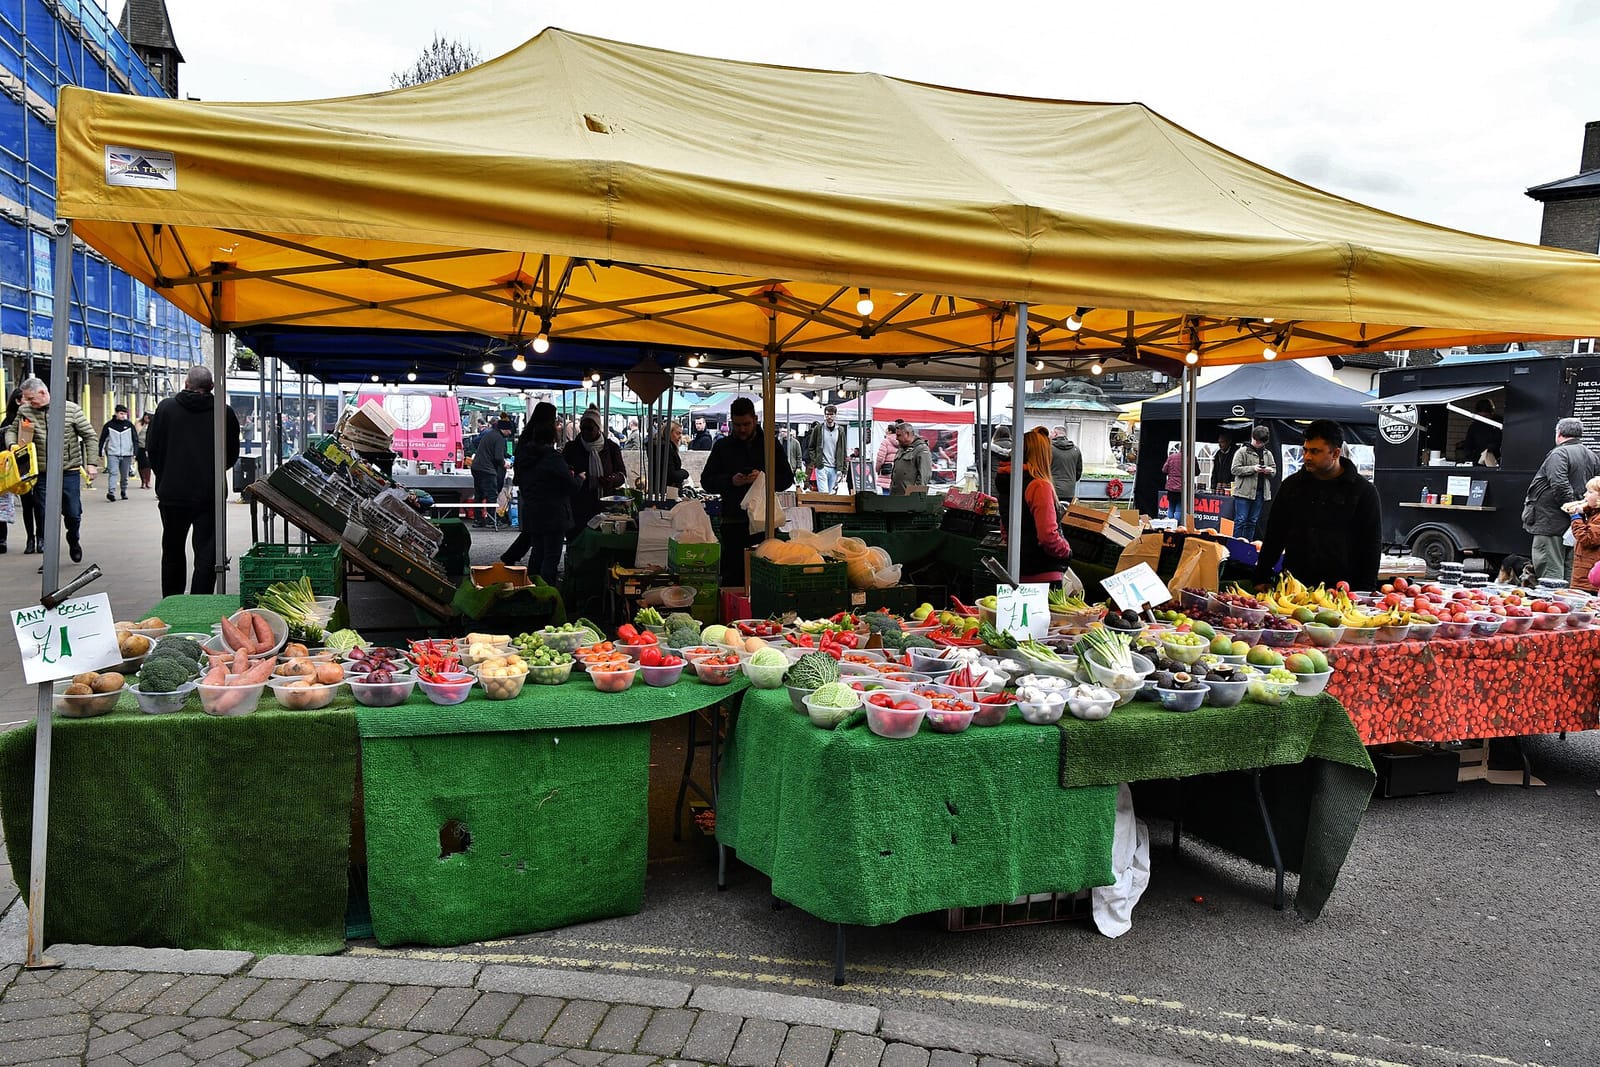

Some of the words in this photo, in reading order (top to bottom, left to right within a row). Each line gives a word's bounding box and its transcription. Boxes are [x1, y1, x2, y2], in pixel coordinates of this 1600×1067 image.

[143, 166, 170, 175] TENT
[16, 608, 46, 626] ANY
[55, 601, 99, 616] BOWL
